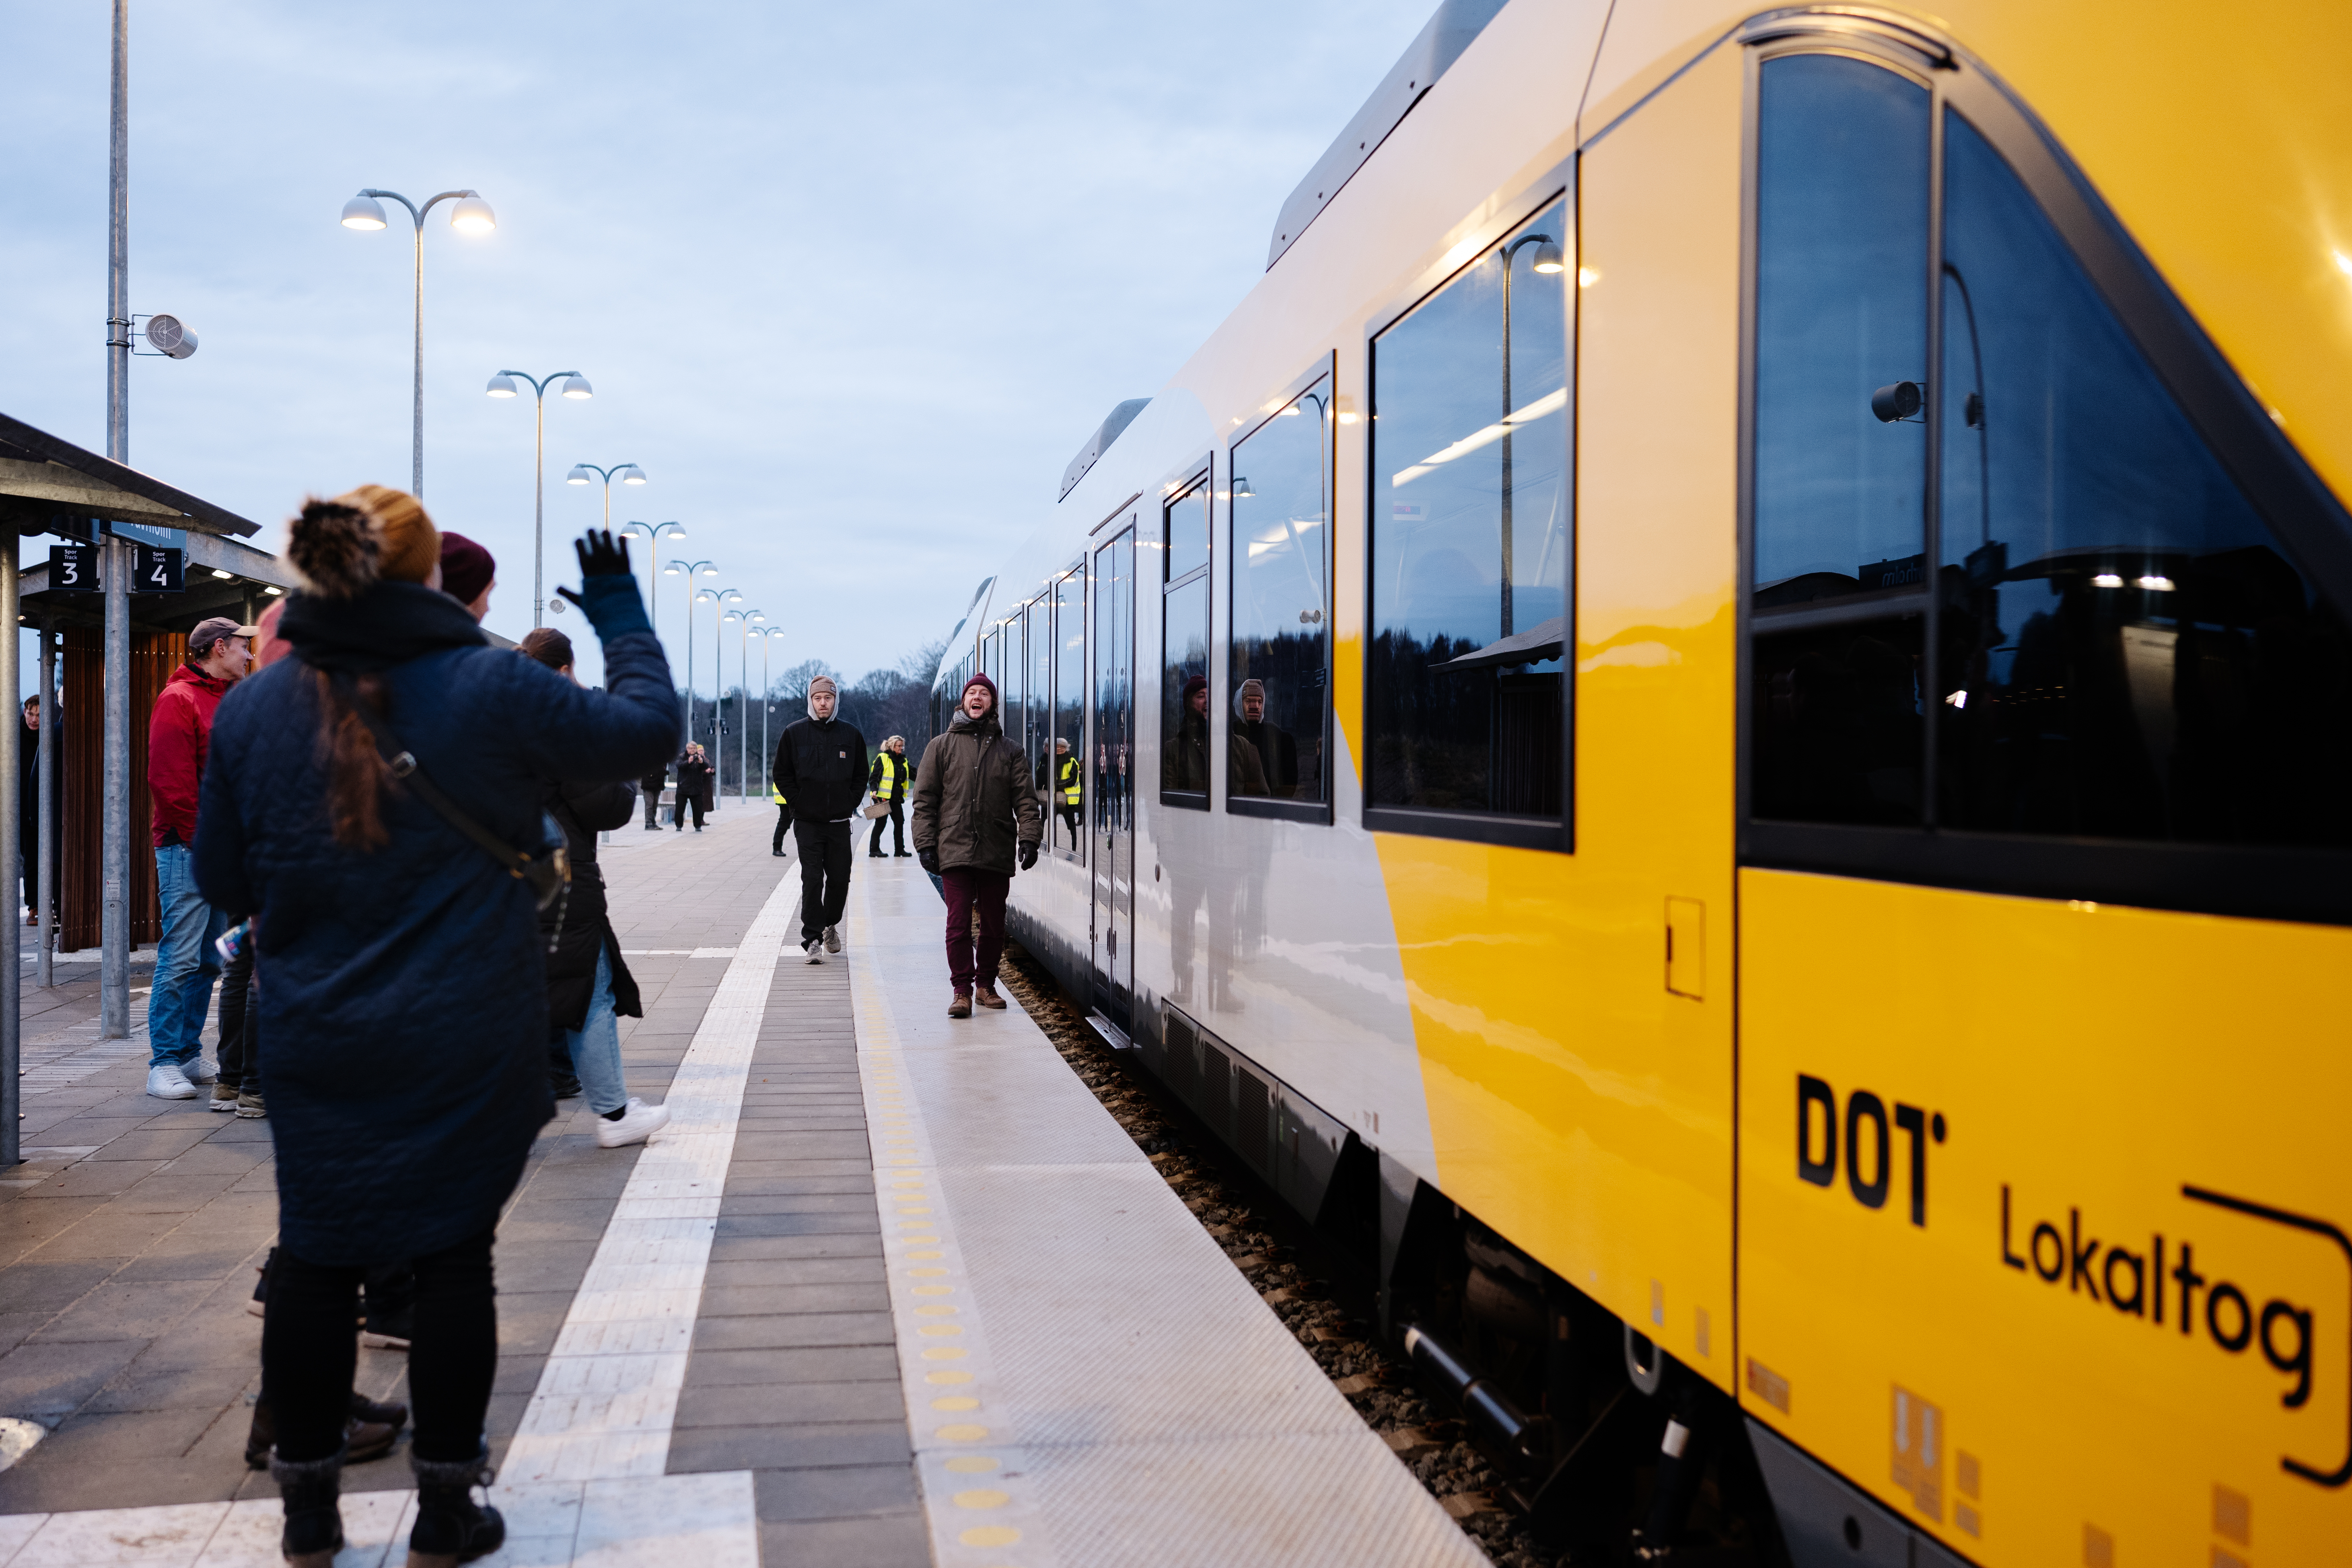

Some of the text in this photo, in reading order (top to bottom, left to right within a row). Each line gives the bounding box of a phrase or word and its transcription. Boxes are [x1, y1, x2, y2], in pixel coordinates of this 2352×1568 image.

[62, 562, 78, 584] 3
[151, 565, 167, 586] 4
[1797, 1073, 1928, 1228] DOT
[2001, 1184, 2315, 1411] Lokaltog
